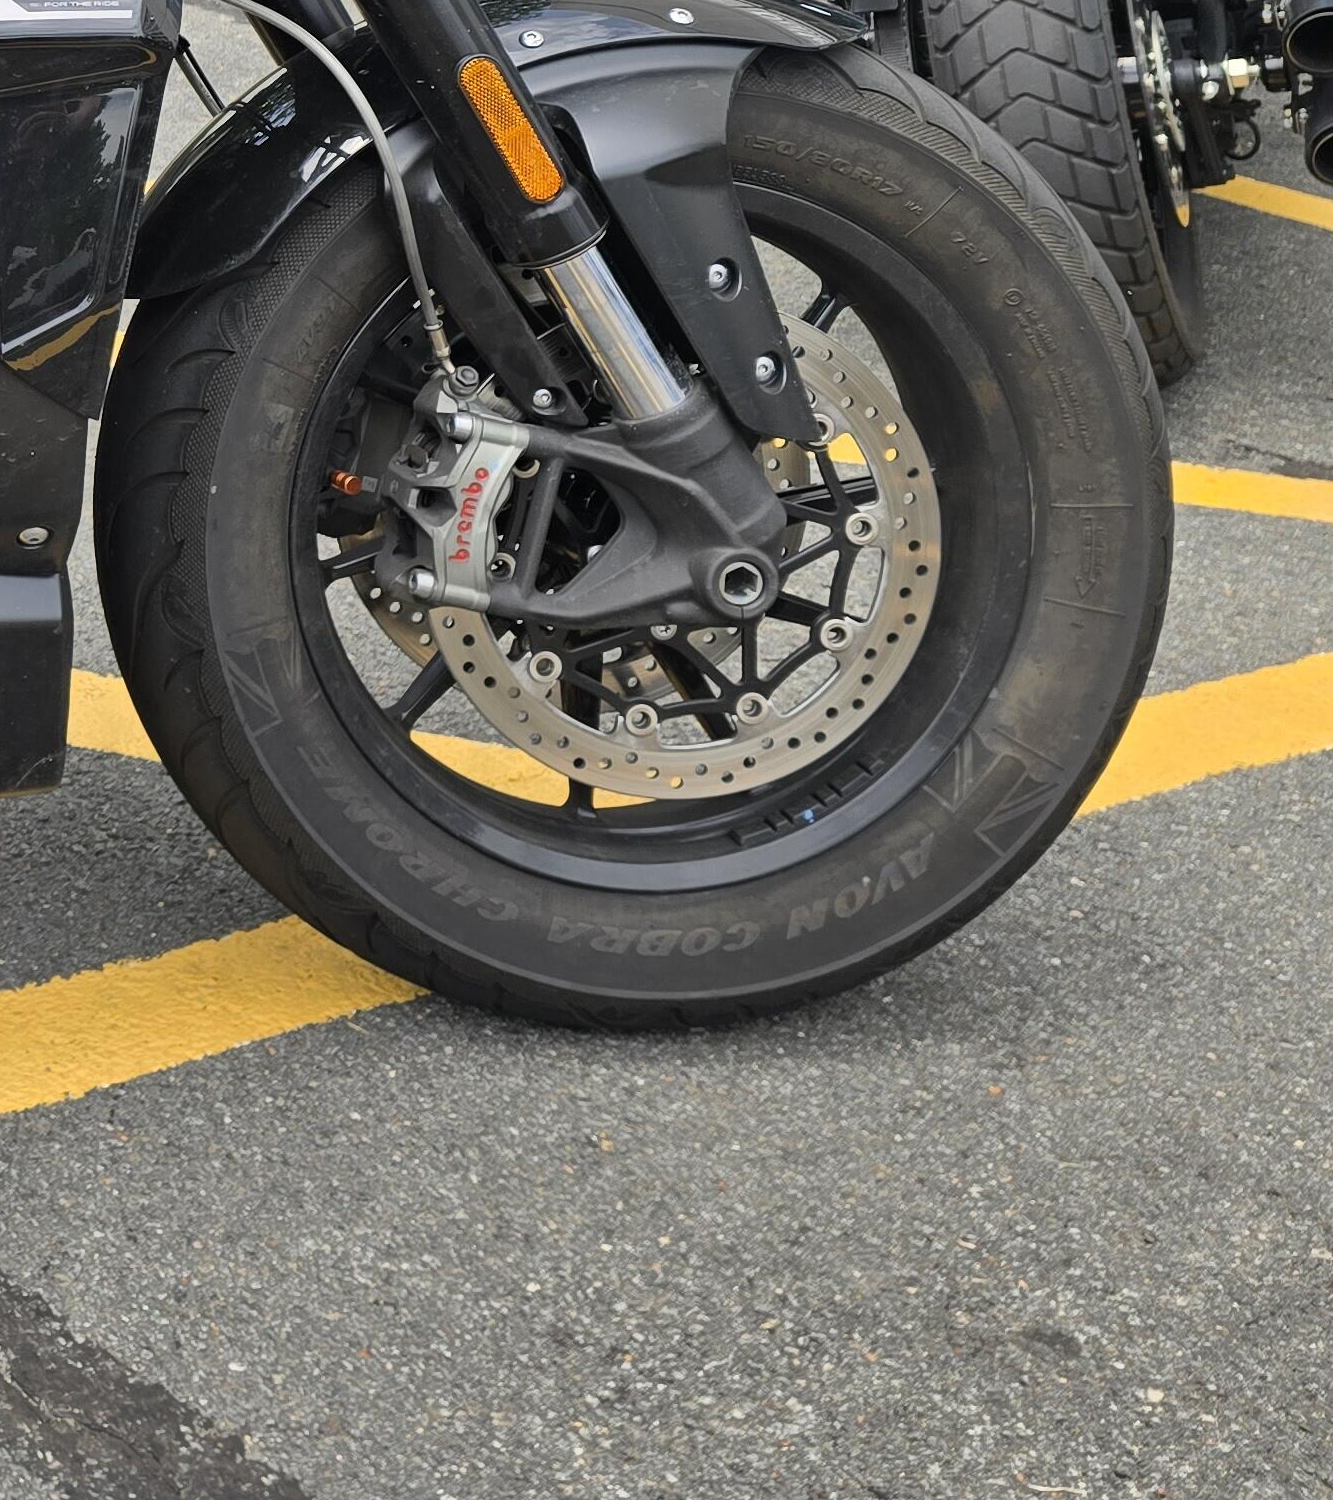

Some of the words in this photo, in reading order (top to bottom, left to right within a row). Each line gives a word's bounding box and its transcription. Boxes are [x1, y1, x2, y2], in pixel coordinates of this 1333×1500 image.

[448, 467, 489, 564] brembo
[297, 744, 517, 925] CHROME
[784, 830, 935, 941] AVON
[547, 915, 765, 957] COBRA
